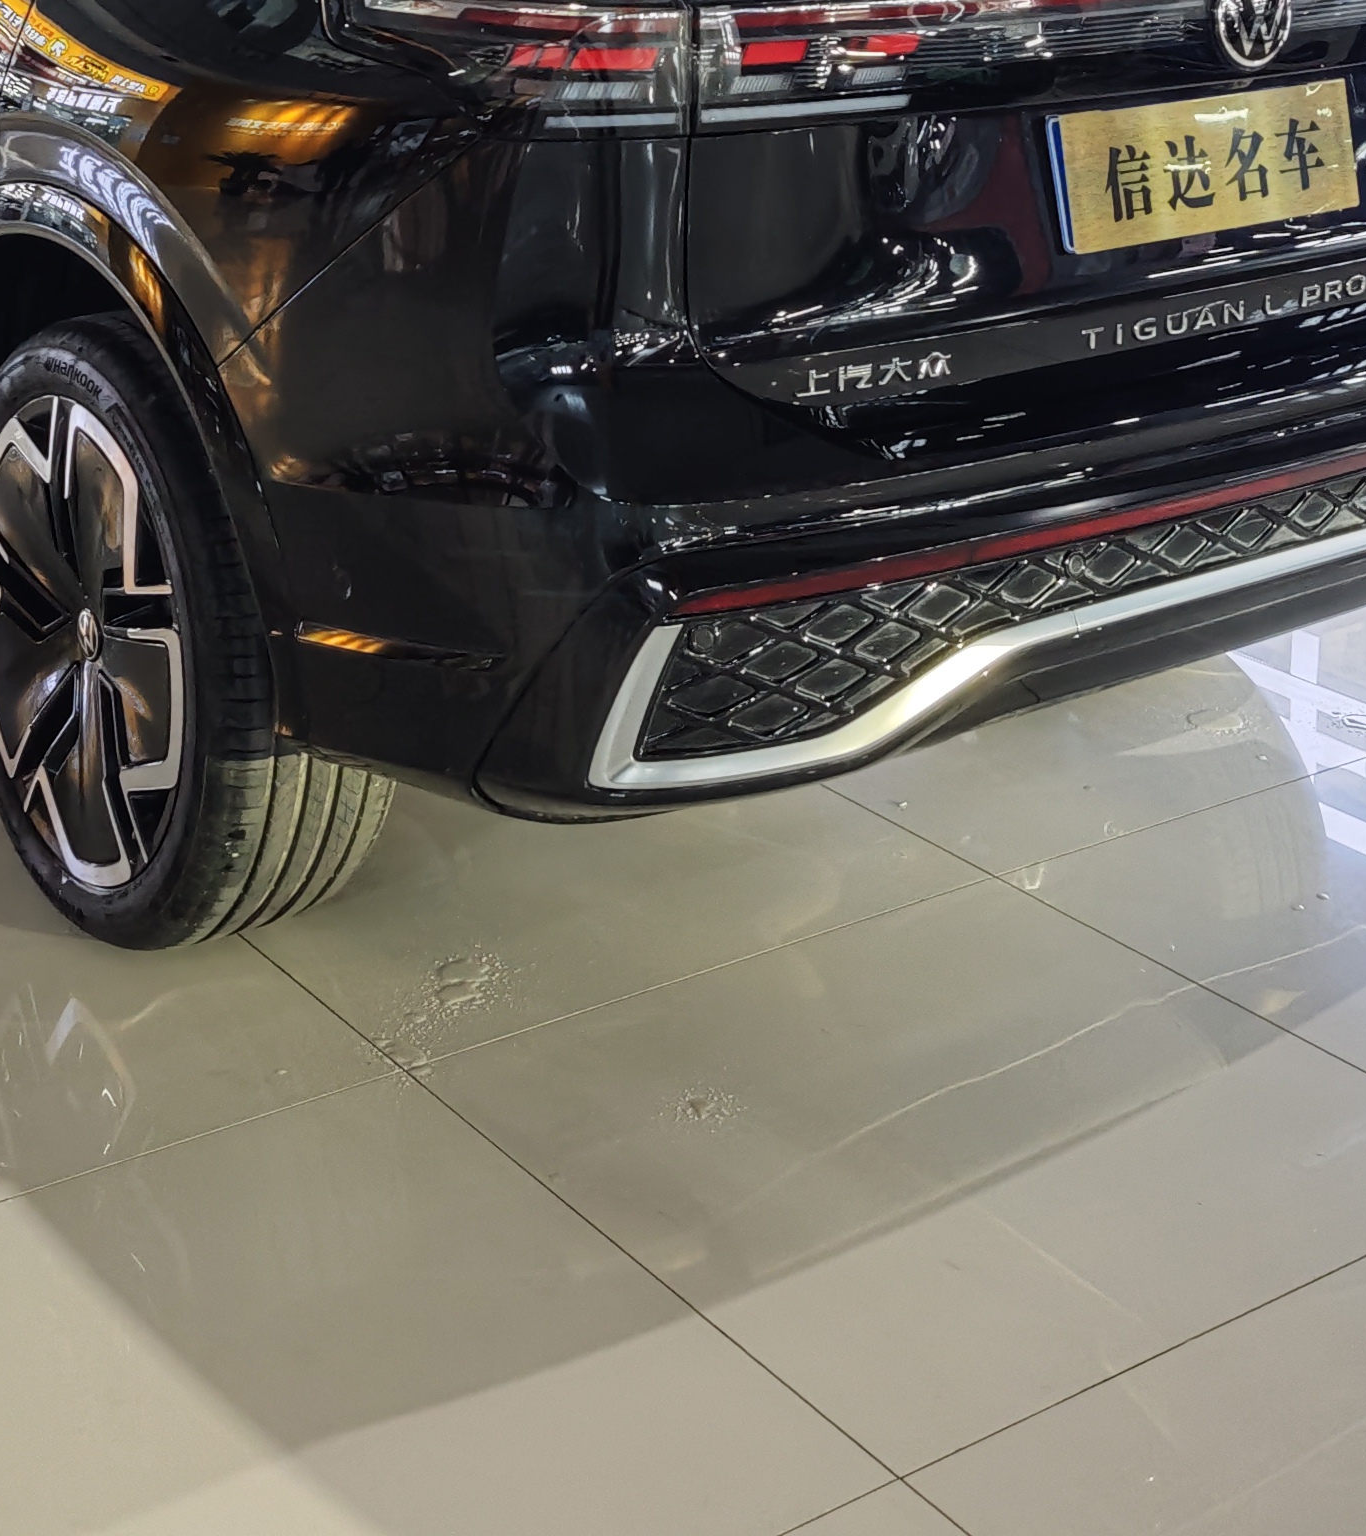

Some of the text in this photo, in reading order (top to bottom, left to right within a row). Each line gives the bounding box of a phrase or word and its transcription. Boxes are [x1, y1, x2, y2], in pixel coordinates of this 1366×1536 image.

[1104, 116, 1332, 224] 信达名车
[1081, 298, 1247, 351] TIGUAN
[1264, 291, 1282, 318] L
[792, 352, 953, 399] 上汽大众
